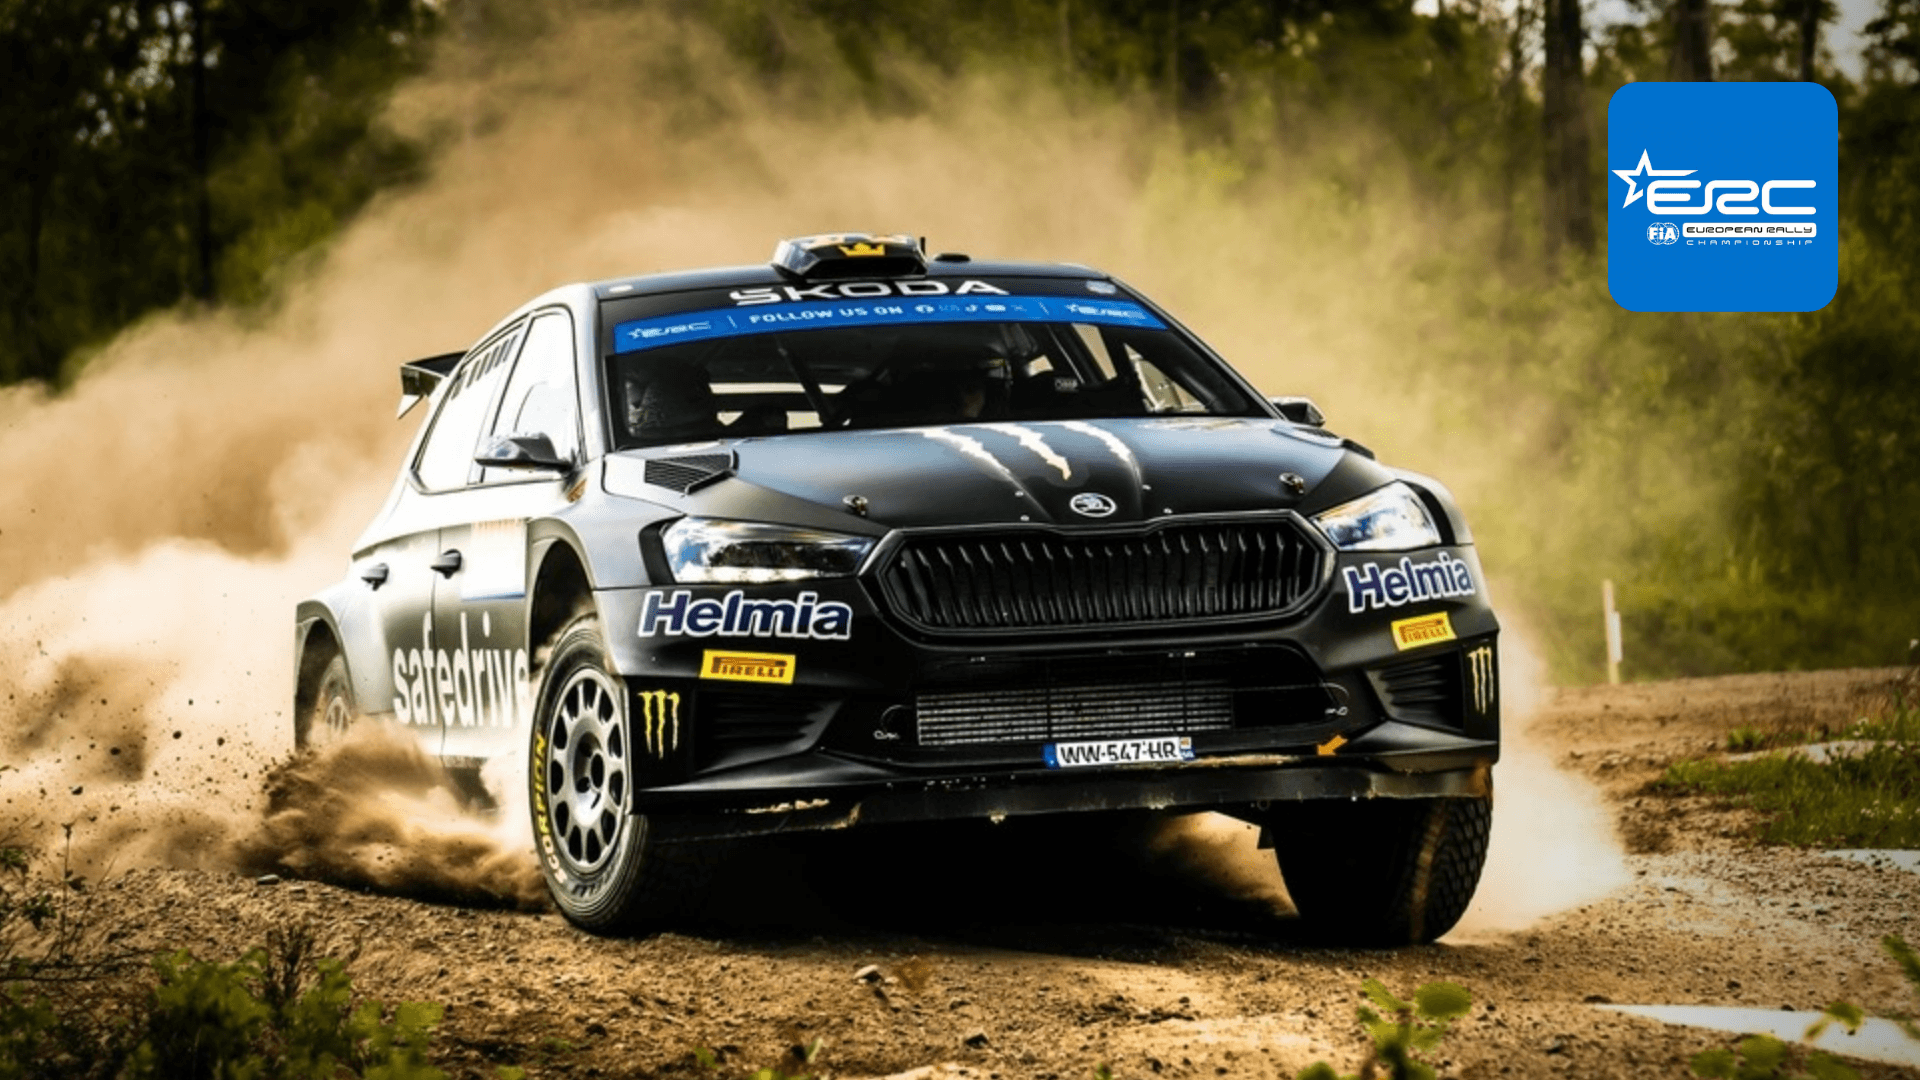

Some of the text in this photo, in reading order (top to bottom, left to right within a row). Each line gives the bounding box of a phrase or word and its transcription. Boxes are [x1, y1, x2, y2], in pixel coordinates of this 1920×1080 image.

[749, 309, 833, 324] FOLLOW
[838, 306, 868, 318] US
[873, 305, 903, 316] ON
[1342, 551, 1476, 614] Helmia
[638, 590, 853, 640] Helmia
[710, 655, 788, 678] PIRELLI
[535, 732, 568, 884] SCORPION
